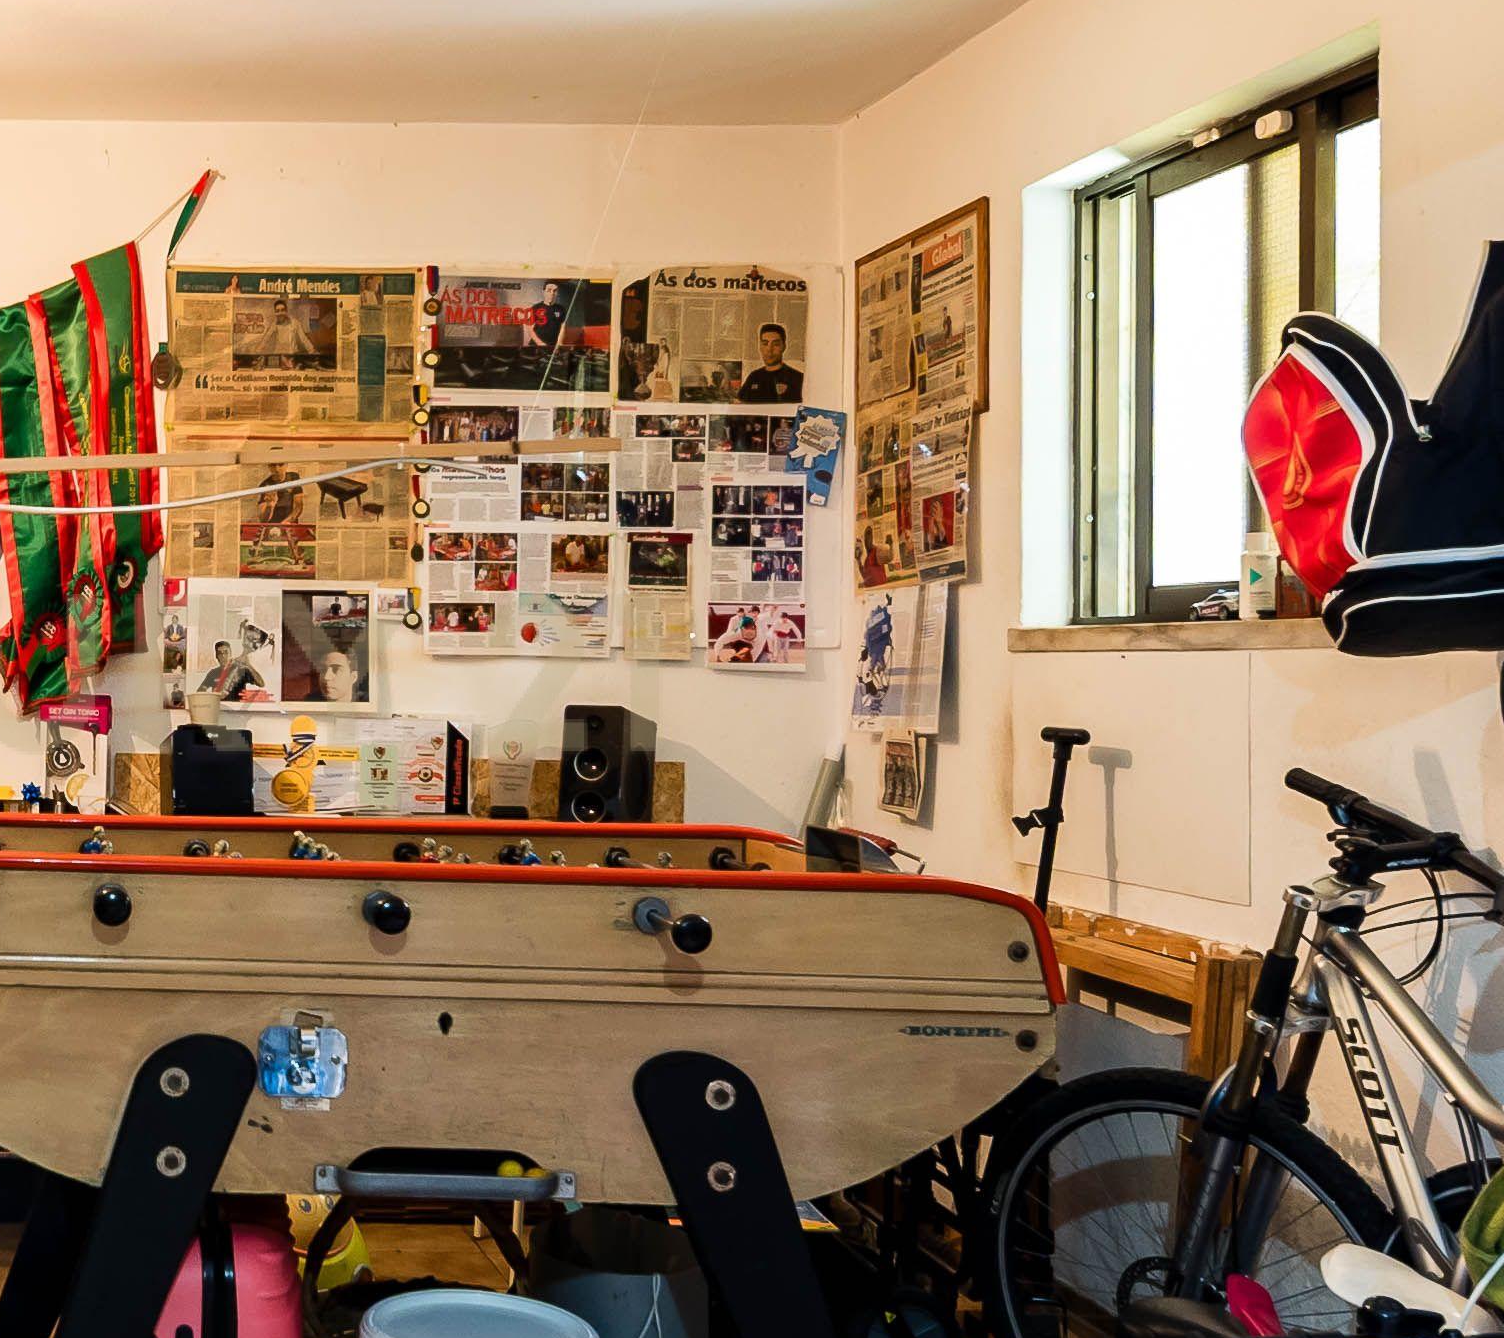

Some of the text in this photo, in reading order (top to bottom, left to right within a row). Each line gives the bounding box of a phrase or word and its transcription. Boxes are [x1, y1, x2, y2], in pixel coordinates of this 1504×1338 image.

[258, 277, 341, 294] André Mendes
[469, 288, 497, 308] DOS
[445, 305, 549, 327] MATRECOS
[232, 373, 268, 383] Cristiano
[269, 374, 302, 383] Ronaldo
[47, 706, 101, 718] SET GIN TONIC
[452, 738, 463, 796] Classificado
[1336, 1017, 1404, 1155] SCOTT
